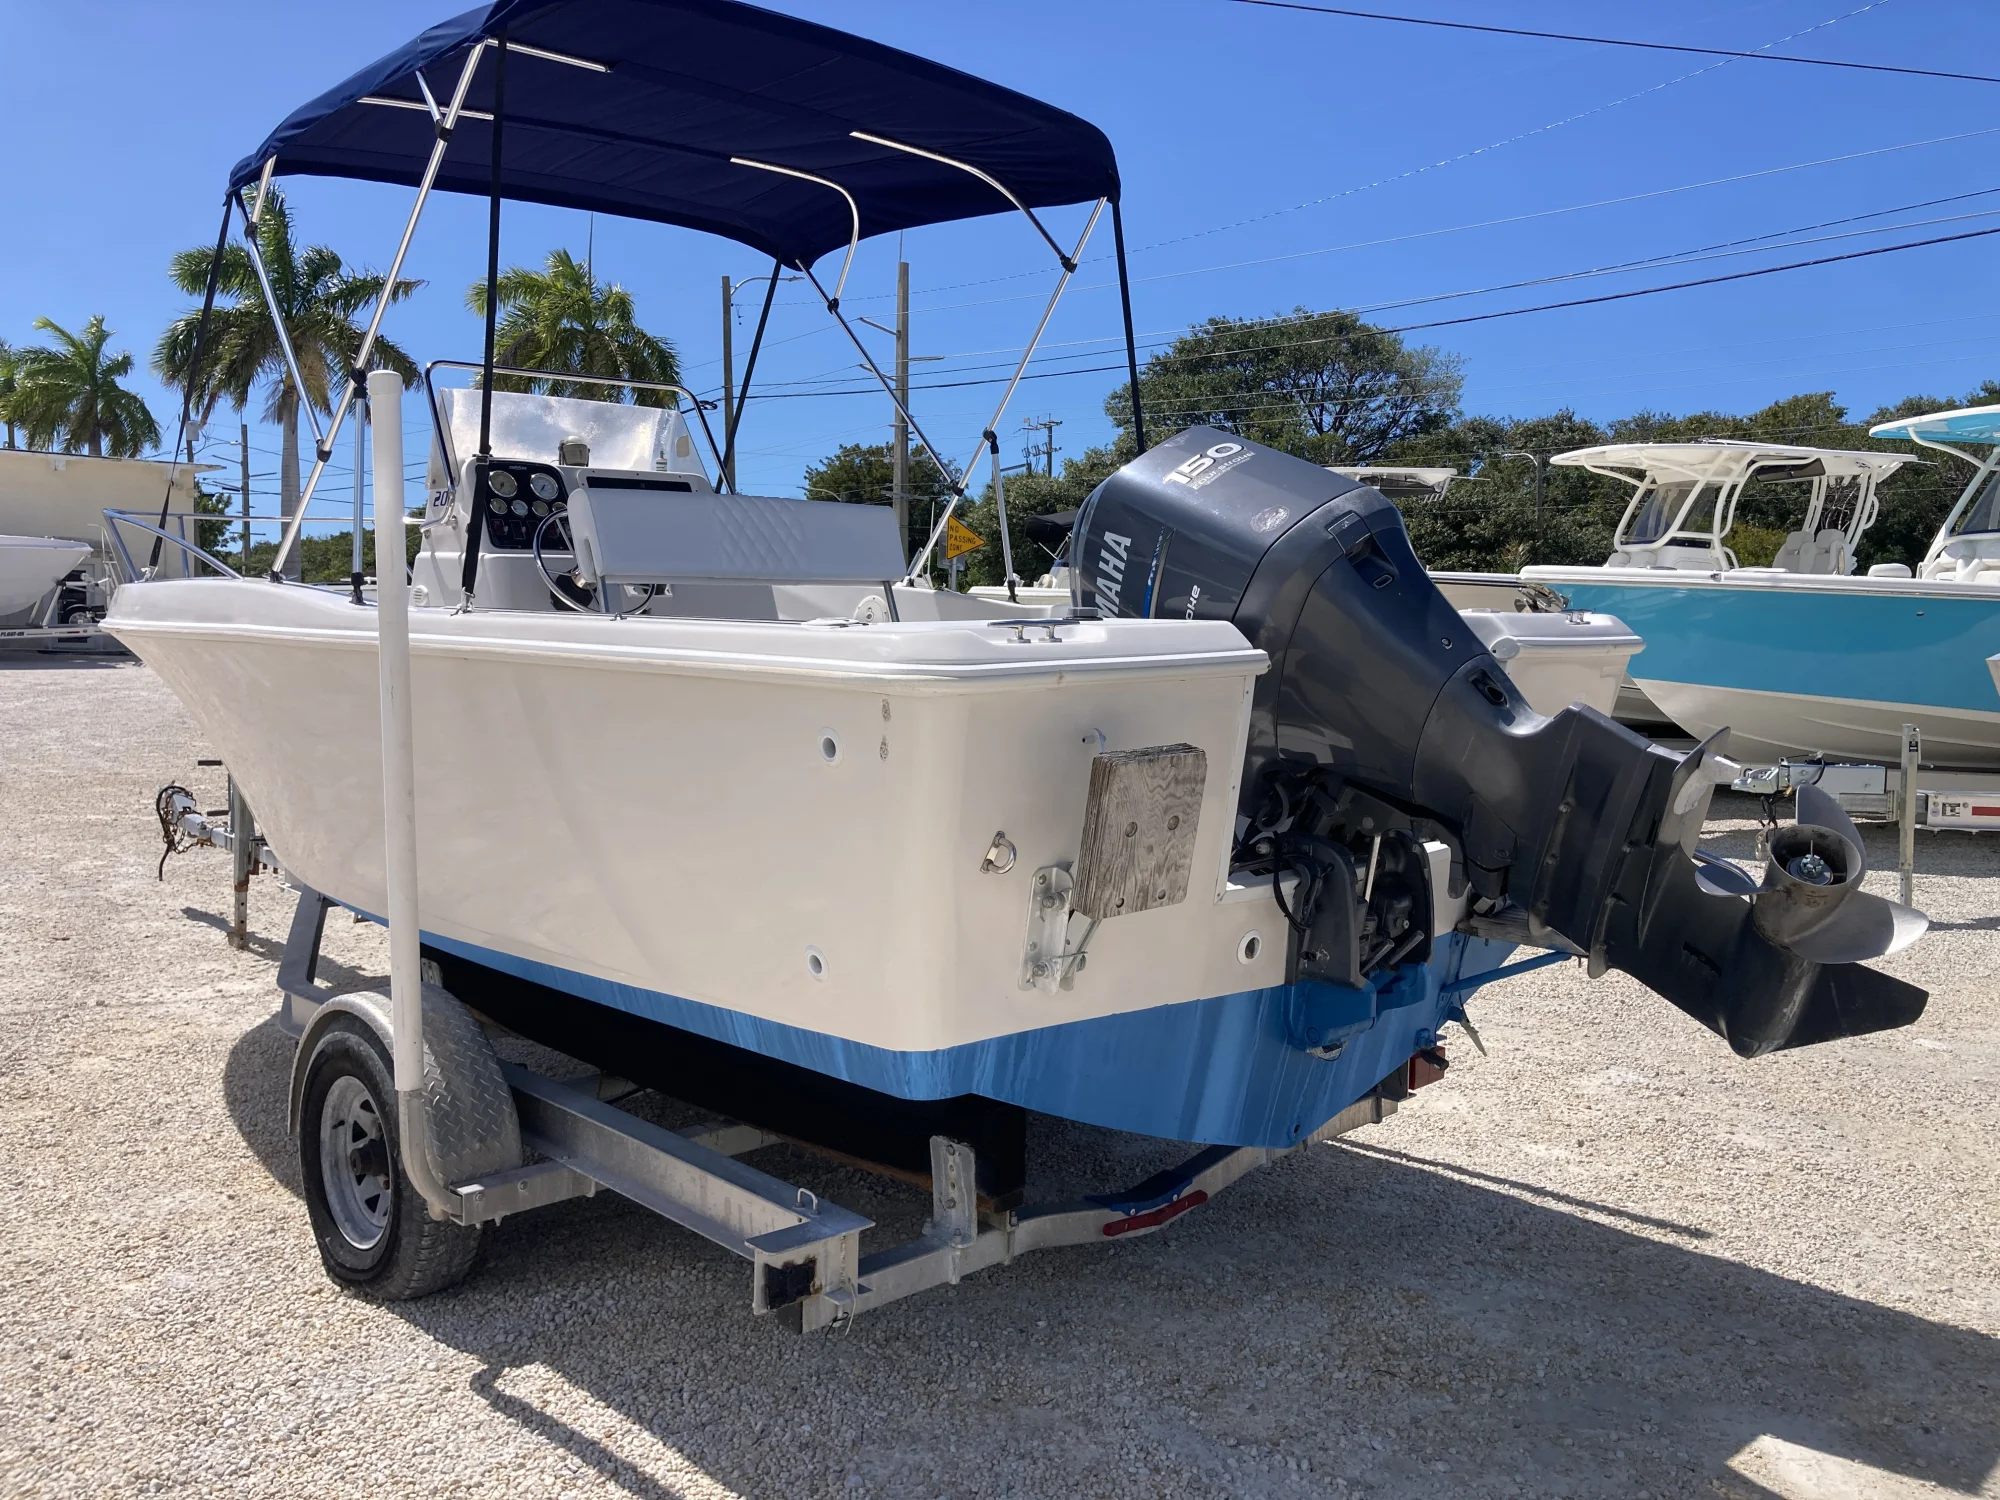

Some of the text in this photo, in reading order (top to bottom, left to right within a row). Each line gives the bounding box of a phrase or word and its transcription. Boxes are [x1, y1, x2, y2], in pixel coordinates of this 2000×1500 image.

[1163, 443, 1244, 485] 150
[950, 525, 959, 533] NO
[949, 534, 975, 544] PASSING
[949, 544, 962, 552] ZONE
[1095, 531, 1132, 619] MAHA
